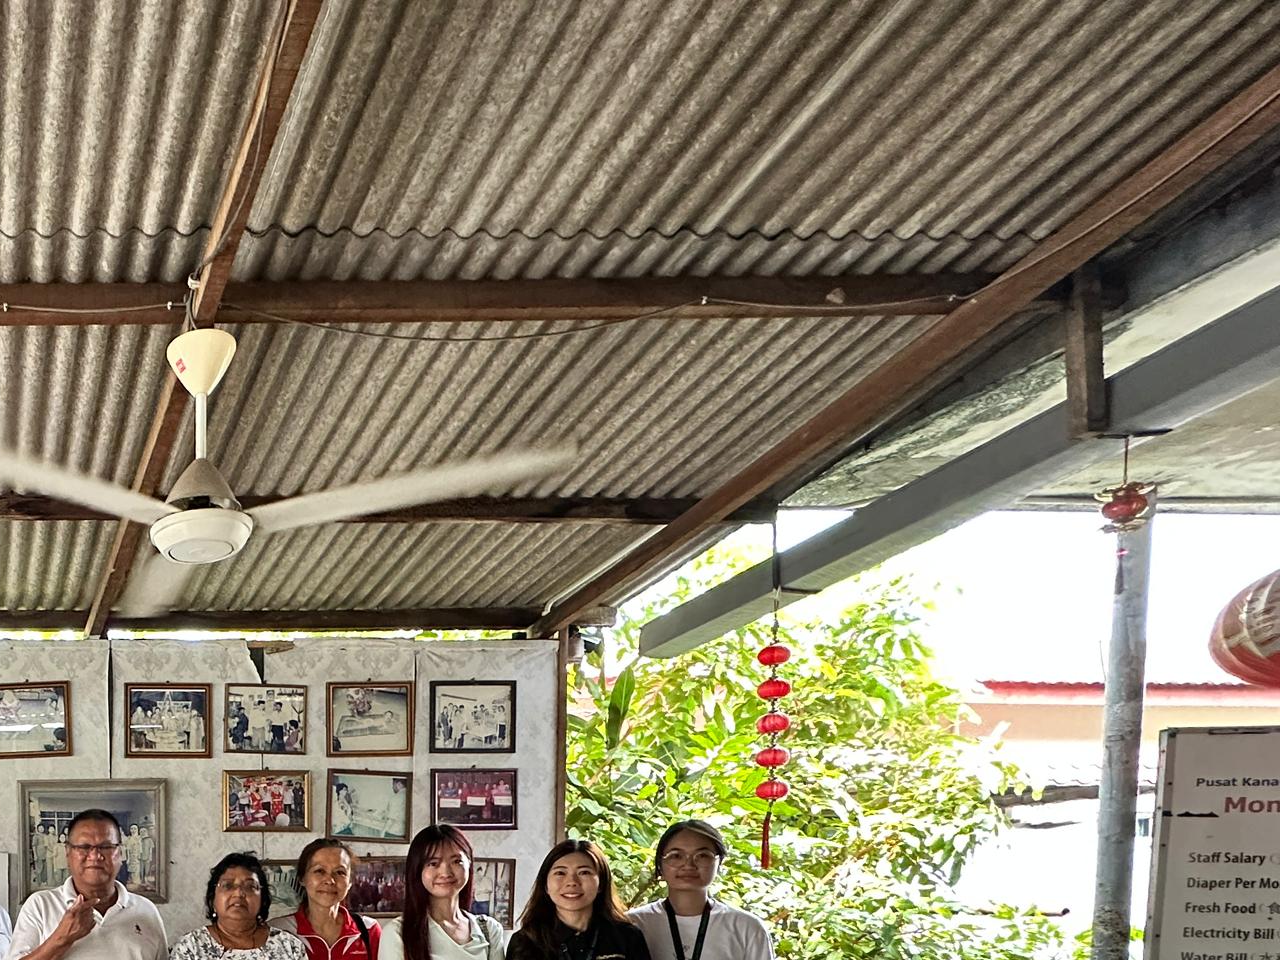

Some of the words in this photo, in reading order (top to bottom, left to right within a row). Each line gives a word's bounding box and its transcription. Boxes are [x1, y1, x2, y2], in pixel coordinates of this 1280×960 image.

[1196, 778, 1238, 787] Pusat
[1242, 777, 1279, 787] Kana
[1188, 851, 1222, 863] Staff
[1224, 852, 1266, 866] Salary
[1187, 877, 1232, 891] Diaper
[1235, 877, 1256, 889] Per
[1185, 902, 1220, 913] Fresh
[1224, 903, 1256, 914] Food
[1183, 926, 1250, 941] Electricity
[1254, 928, 1275, 940] Bill
